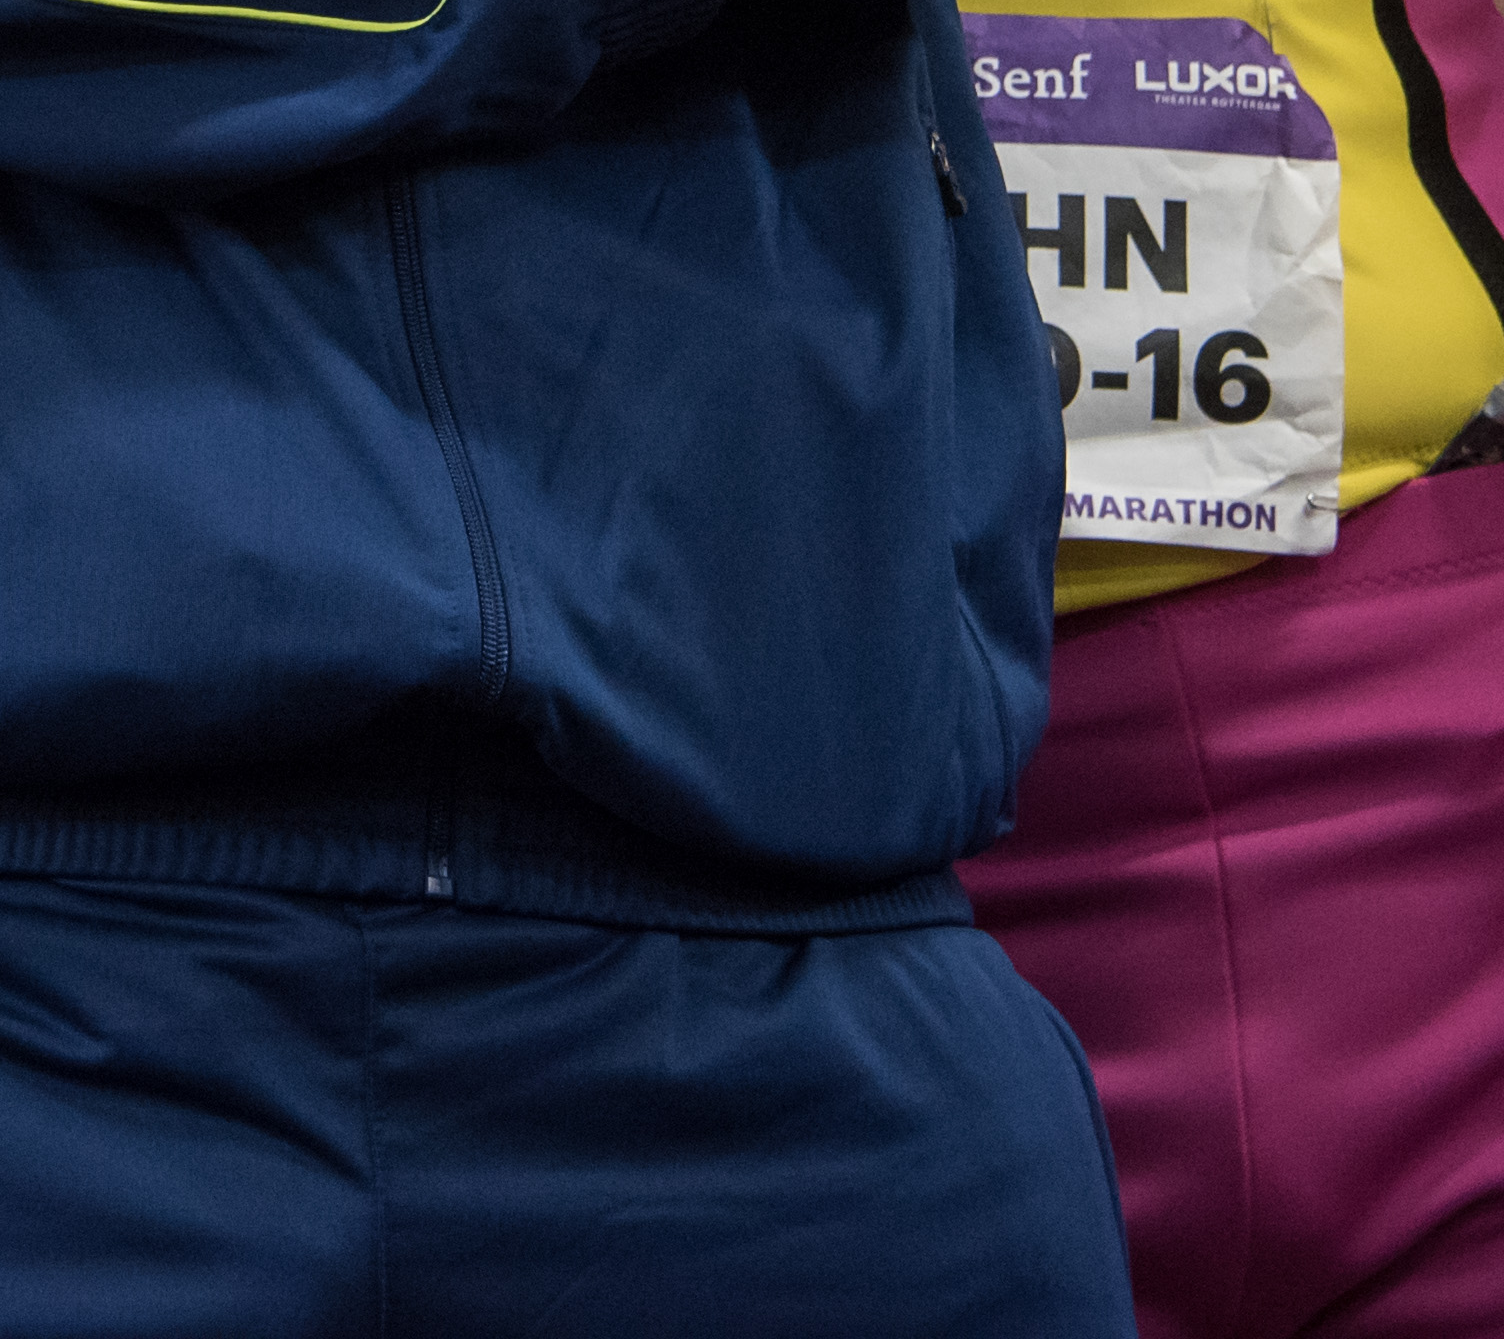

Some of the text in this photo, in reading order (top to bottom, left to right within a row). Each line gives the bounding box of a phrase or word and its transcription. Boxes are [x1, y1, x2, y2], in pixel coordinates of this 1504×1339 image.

[974, 53, 1091, 100] Senf
[1135, 60, 1298, 100] LUXOR
[1064, 492, 1277, 533] MARATHON
